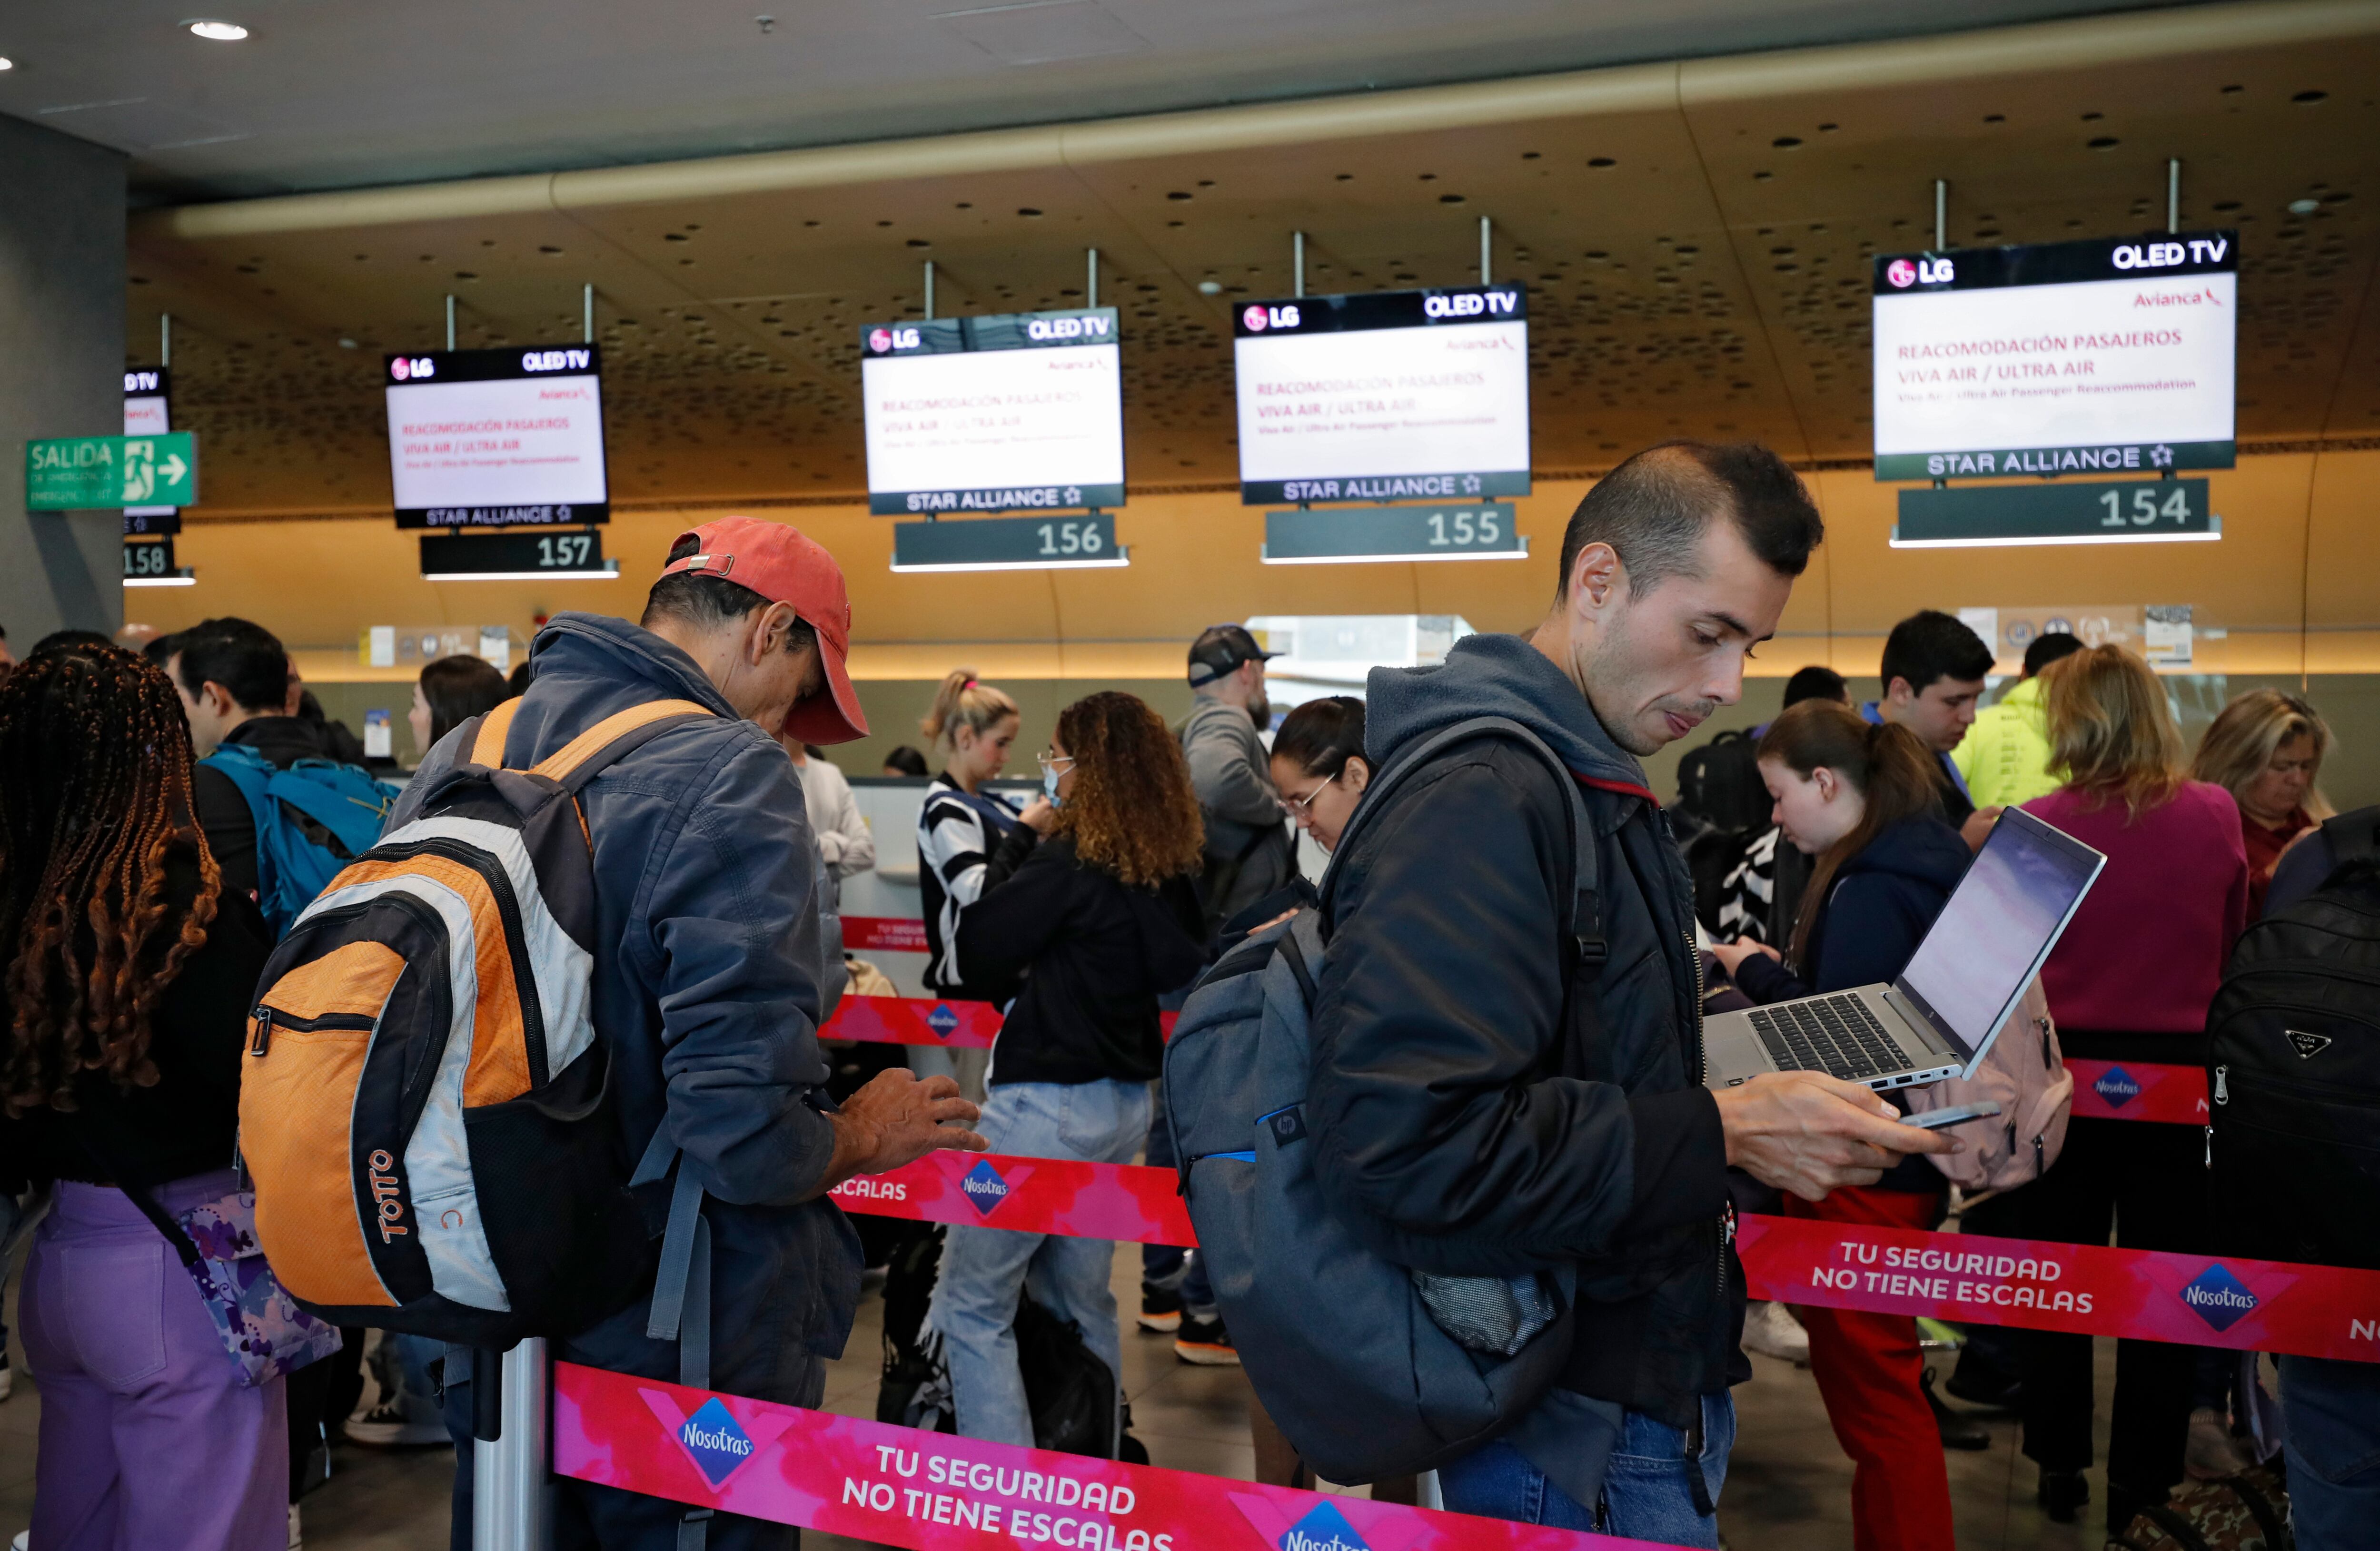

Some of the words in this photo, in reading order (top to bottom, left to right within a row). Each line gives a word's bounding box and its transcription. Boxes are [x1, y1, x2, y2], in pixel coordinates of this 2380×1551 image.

[2112, 243, 2185, 270] OLED
[2189, 239, 2227, 264] TV
[1920, 258, 1954, 283] LG
[1425, 294, 1484, 317] OLED
[1484, 292, 1517, 313] TV
[2134, 292, 2202, 307] Avianca
[1028, 319, 1081, 340] OLED
[1081, 316, 1110, 336] TV
[1269, 306, 1300, 327] LG
[892, 328, 920, 349] LG
[1898, 334, 2067, 358] REACOMODACIÓN
[2074, 329, 2182, 354] PASAJEROS
[410, 358, 434, 378] LG
[523, 352, 565, 372] OLED
[565, 350, 590, 369] TV
[1899, 368, 1942, 384] VIVA
[1948, 366, 1976, 381] AIR
[1998, 362, 2057, 380] ULTRA
[2063, 361, 2095, 376] AIR
[31, 442, 113, 470] SALIDA
[1927, 454, 1995, 475] STAR
[2003, 447, 2140, 472] ALLIANCE
[906, 492, 957, 512] STAR
[961, 487, 1059, 509] ALLIANCE
[1284, 480, 1339, 500] STAR
[1345, 475, 1455, 498] ALLIANCE
[426, 508, 468, 525] STAR
[472, 505, 554, 524] ALLIANCE
[2100, 487, 2191, 526] 154
[1037, 522, 1102, 555] 156
[1428, 510, 1500, 545] 155
[124, 546, 166, 574] 158
[537, 535, 592, 566] 157
[2096, 1080, 2138, 1095] Nosotras
[369, 1149, 408, 1244] TOTTO
[964, 1177, 1007, 1196] Nosotras
[1841, 1242, 1877, 1265] TU
[1885, 1246, 2061, 1282] SEGURIDAD
[1812, 1266, 1857, 1290] NO
[1864, 1272, 1948, 1300] TIENE
[1956, 1281, 2093, 1314] ESCALAS
[2186, 1285, 2254, 1309] Nosotras
[2349, 1318, 2380, 1341] N
[684, 1423, 750, 1456] Nosotras
[875, 1444, 919, 1478] TU
[927, 1455, 1135, 1515] SEGURIDAD
[842, 1477, 895, 1512] NO
[903, 1488, 1002, 1534] TIENE
[1010, 1509, 1174, 1551] ESCALAS
